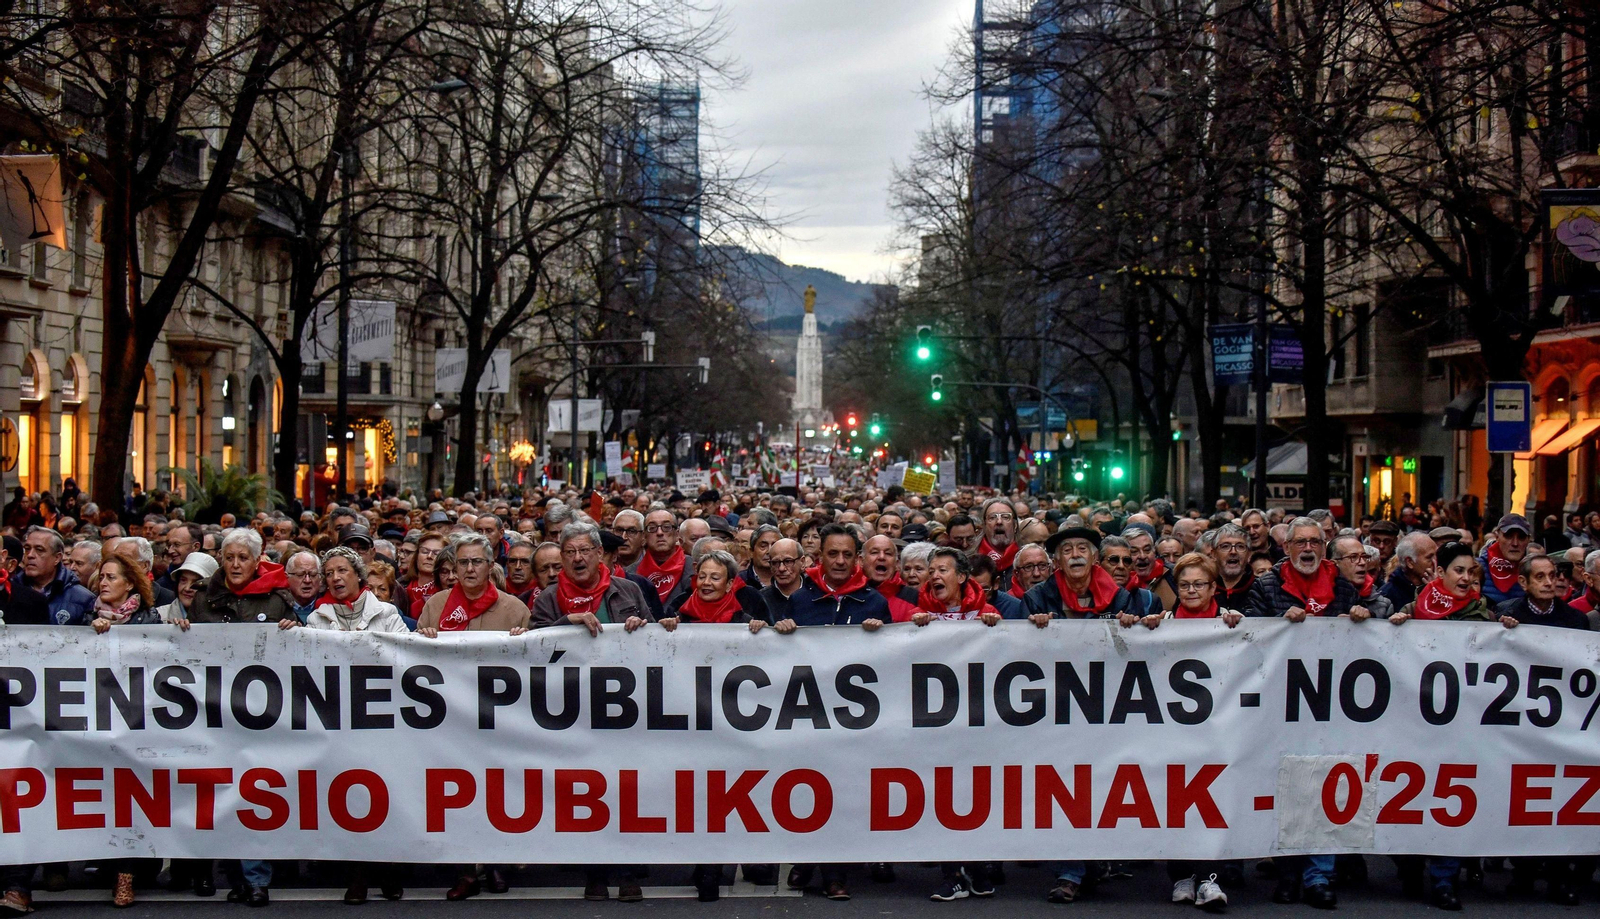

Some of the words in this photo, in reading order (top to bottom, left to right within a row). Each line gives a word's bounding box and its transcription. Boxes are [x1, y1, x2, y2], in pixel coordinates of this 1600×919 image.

[1213, 337, 1226, 346] DE
[1231, 335, 1253, 344] VAN
[1214, 344, 1243, 355] GOGH
[1215, 361, 1254, 371] PICASSO
[0, 664, 446, 732] PENSIONES
[478, 650, 880, 732] PÚBLICAS
[911, 658, 1214, 728] DIGNAS
[1240, 692, 1261, 708] -
[1285, 658, 1391, 723] NO
[0, 767, 389, 834] PENTSIO
[426, 768, 834, 834] PUBLIKO
[870, 764, 1229, 832] DUINAK
[1253, 795, 1274, 811] -
[1321, 753, 1478, 828] 0'25
